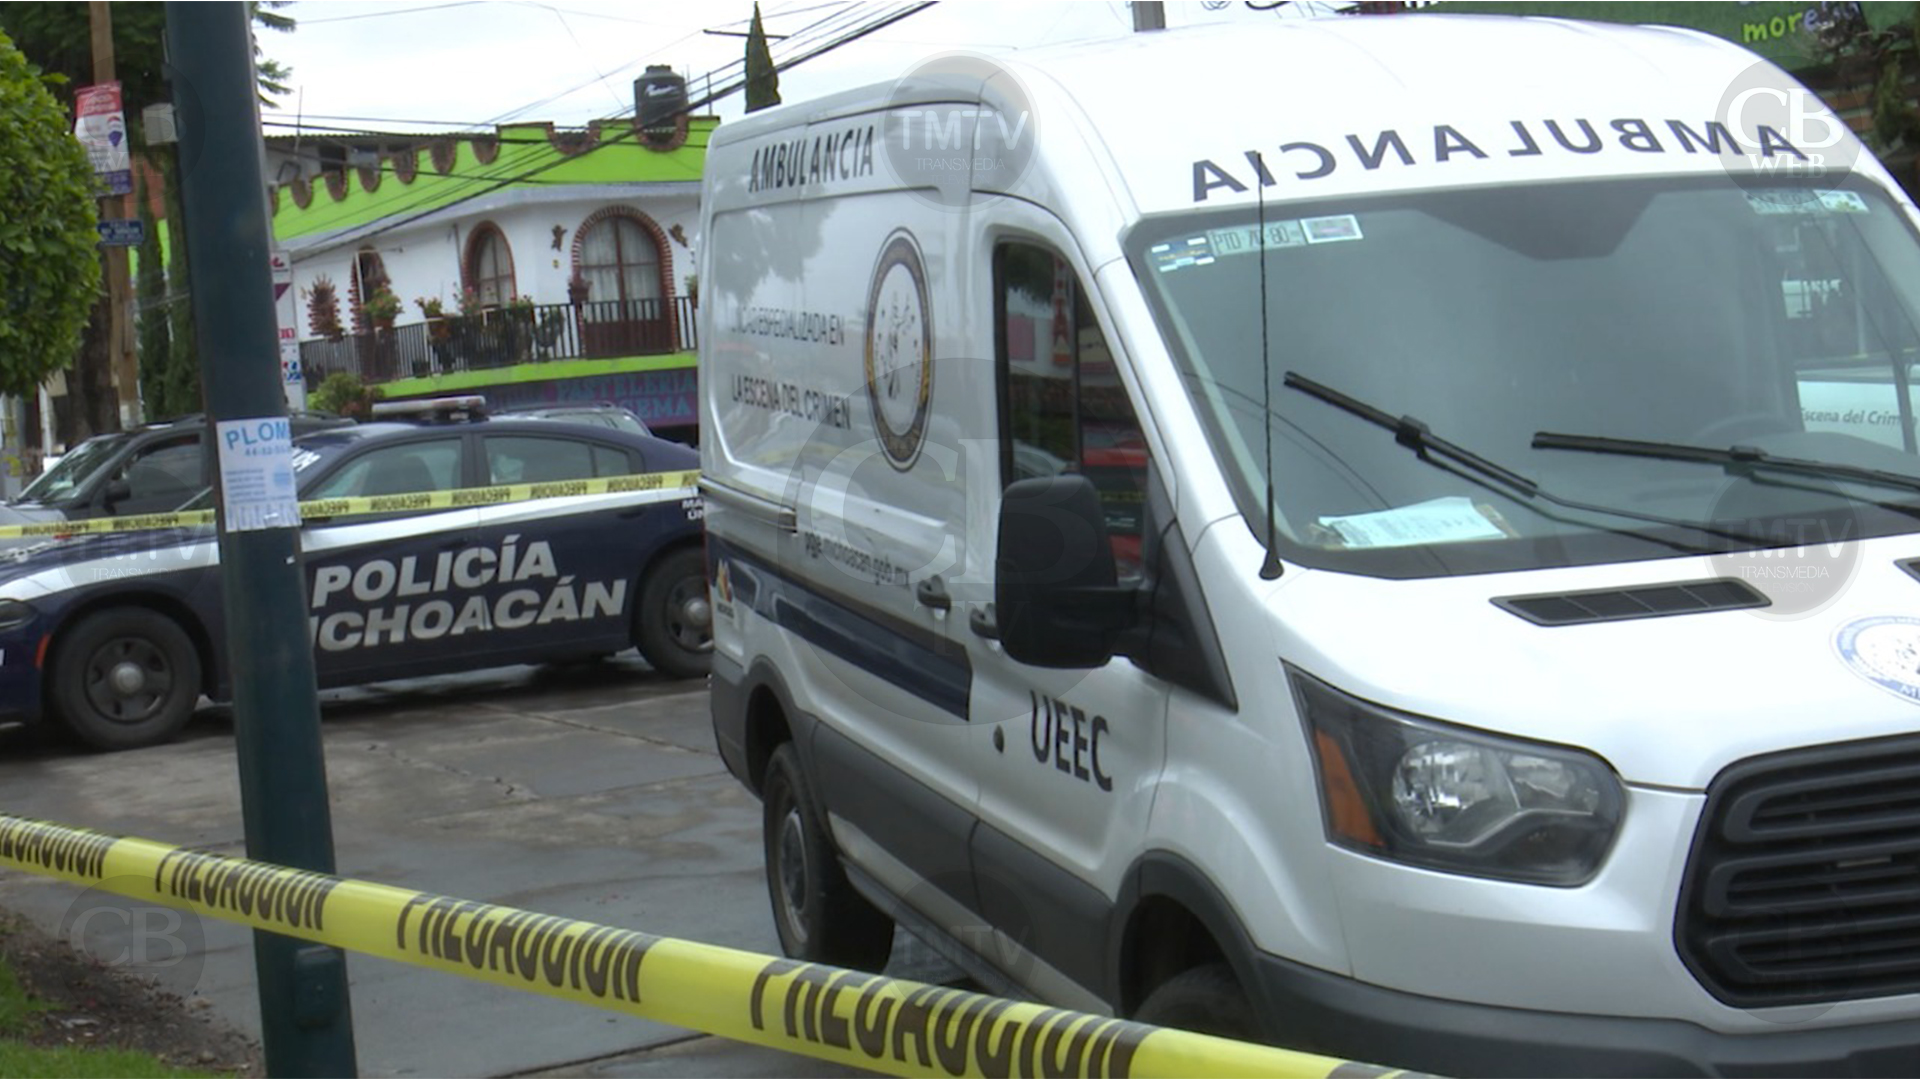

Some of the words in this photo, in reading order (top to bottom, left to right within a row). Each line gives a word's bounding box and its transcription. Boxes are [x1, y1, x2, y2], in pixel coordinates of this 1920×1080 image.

[749, 125, 874, 193] AMBULANCIA
[1842, 409, 1866, 425] del
[311, 534, 558, 608] POLICÍA
[310, 575, 629, 652] CHOACÁN
[1030, 690, 1113, 792] UEEC
